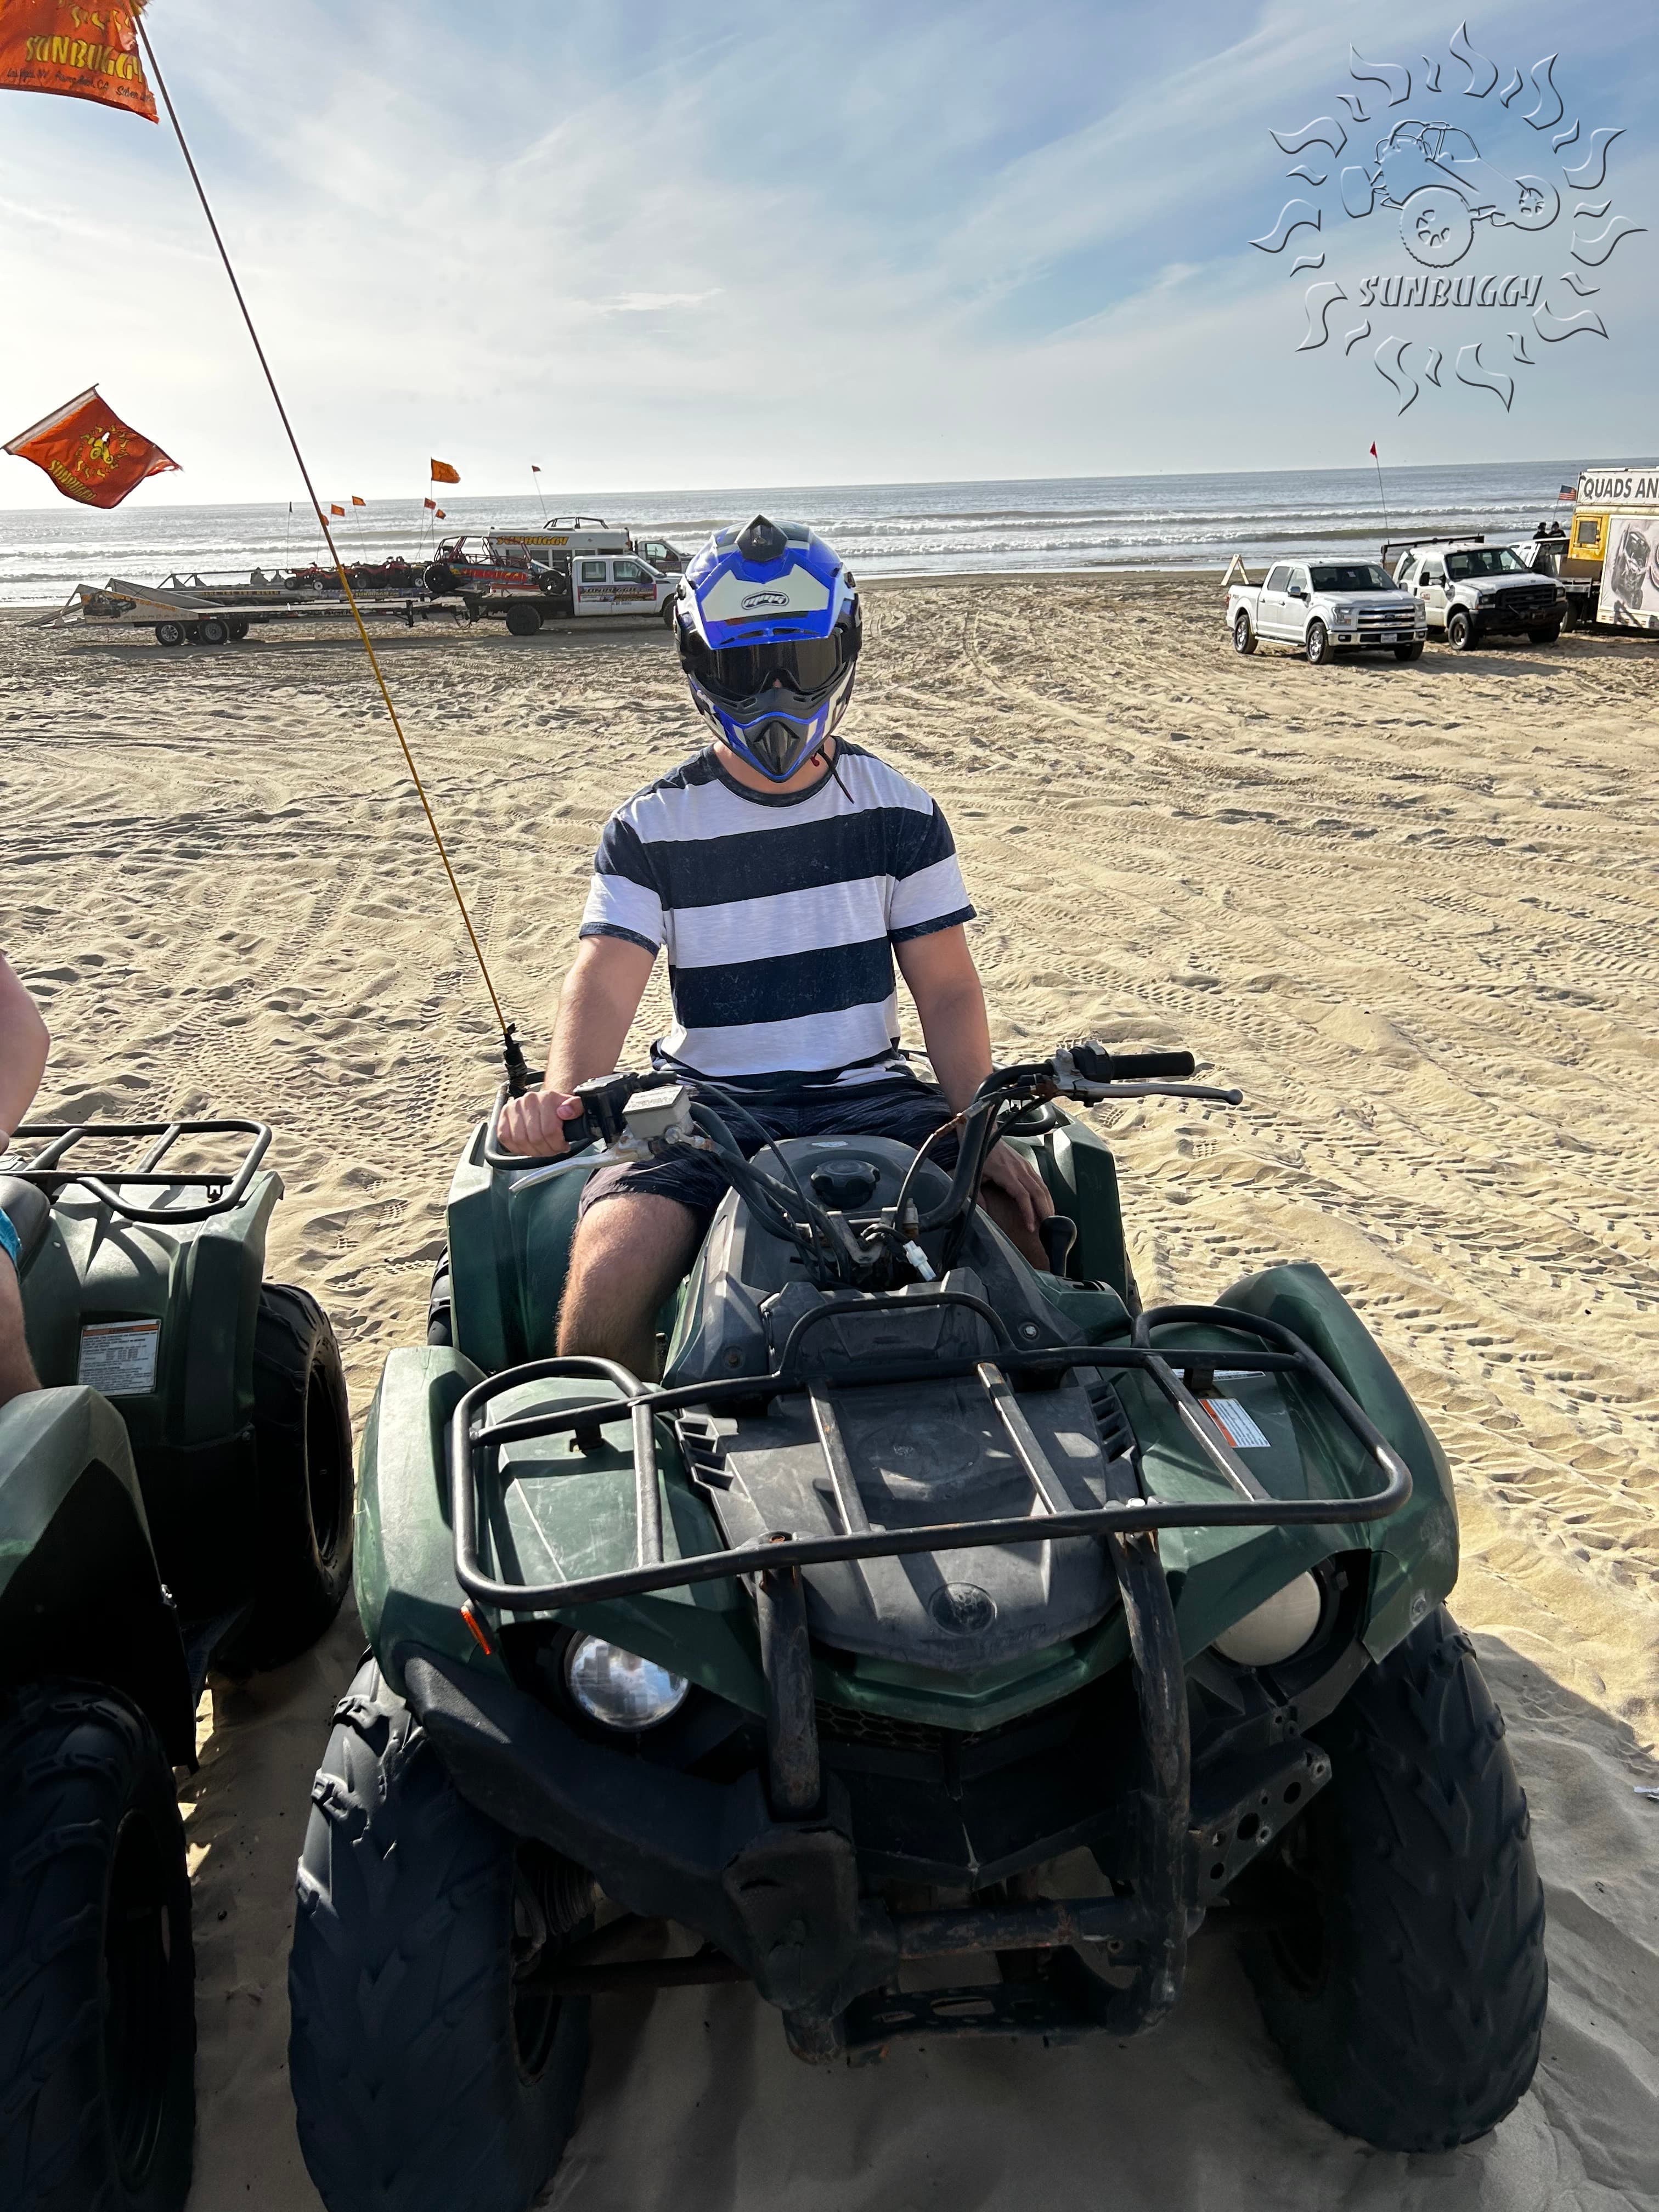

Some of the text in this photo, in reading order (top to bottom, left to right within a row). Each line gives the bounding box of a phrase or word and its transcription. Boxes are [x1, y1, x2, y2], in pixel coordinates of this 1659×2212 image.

[1584, 478, 1659, 499] QUADS AN
[496, 535, 569, 545] SUNBUGGY
